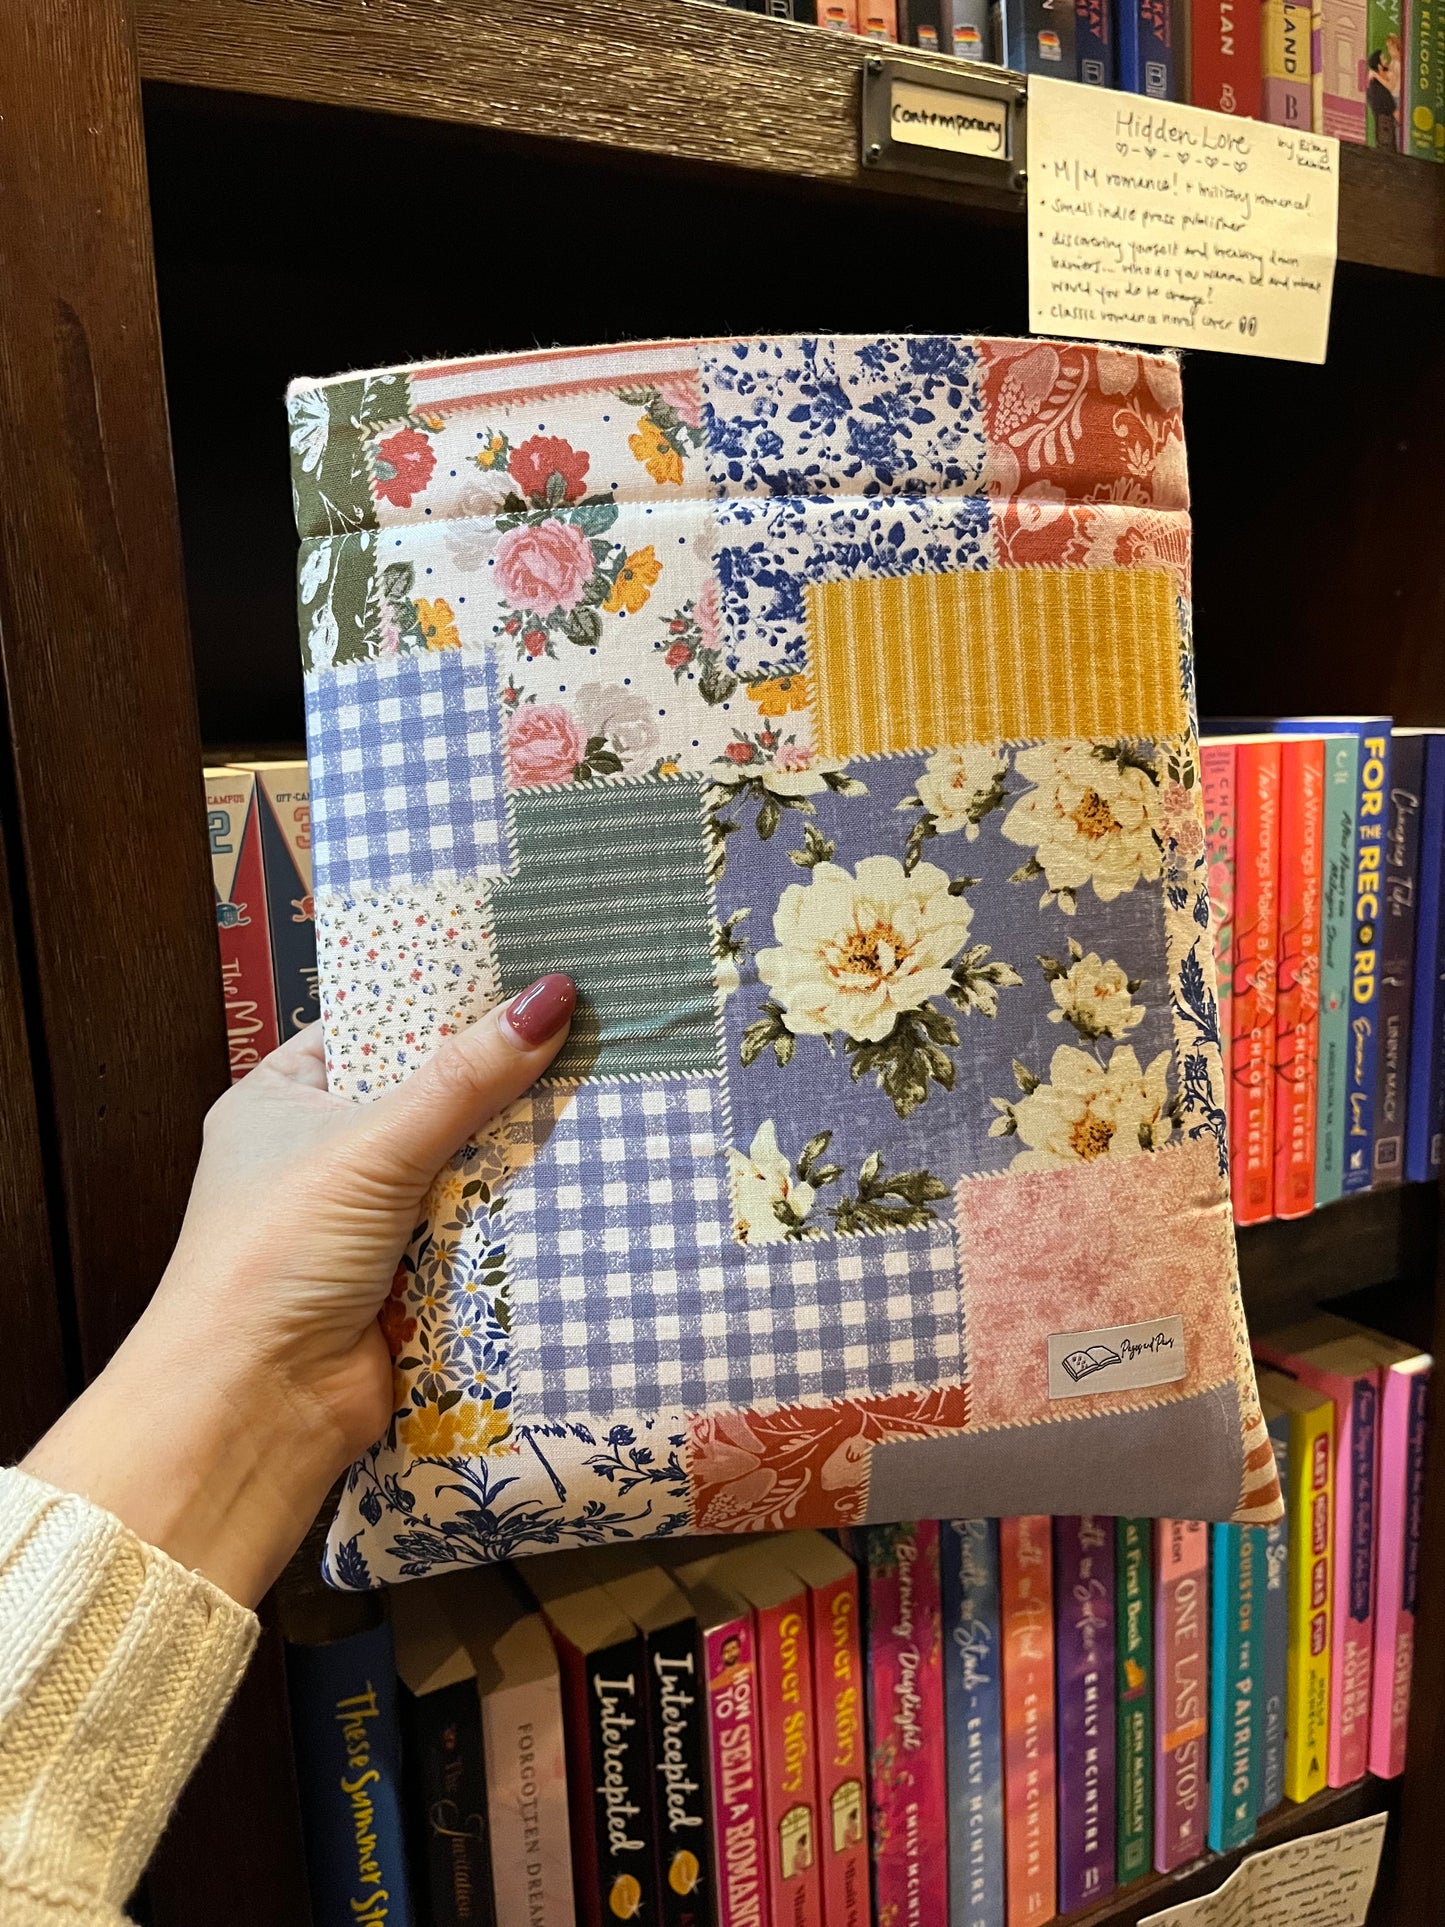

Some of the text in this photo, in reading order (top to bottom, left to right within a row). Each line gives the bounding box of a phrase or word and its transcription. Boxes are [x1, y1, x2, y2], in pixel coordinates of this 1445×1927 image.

[891, 103, 1002, 152] Contemporary
[1116, 110, 1251, 155] Hidden Love
[207, 794, 245, 806] CAMPUS
[276, 793, 310, 803] OFF-CA
[1300, 796, 1319, 874] Wrongs
[1255, 799, 1275, 878] Wrongs
[1257, 881, 1272, 932] Make
[1302, 878, 1316, 930] Make
[1302, 933, 1314, 947] a
[1350, 737, 1386, 1136] FOR THE RECORD Emma Lord
[1257, 937, 1270, 951] a
[1247, 1027, 1262, 1170] CHLOE LIESE
[1291, 1023, 1306, 1164] CHLOE LIESE
[1313, 1437, 1326, 1487] LAST
[1127, 1549, 1141, 1597] First
[1175, 1579, 1197, 1645] ONE
[831, 1590, 853, 1680] Cover
[892, 1537, 922, 1750] Burning Daylight
[1127, 1600, 1141, 1651] Book
[336, 1680, 380, 1768] These
[714, 1688, 734, 1719] TO
[733, 1670, 751, 1720] HOW
[779, 1614, 807, 1792] Cover Story
[1025, 1694, 1039, 1759] EMILY
[1084, 1672, 1098, 1737] EMILY
[1175, 1654, 1198, 1733] LAST
[1342, 1641, 1355, 1736] MONROE
[595, 1673, 645, 1856] Intercepted
[654, 1652, 702, 1832] Intercepted
[720, 1724, 754, 1805] SELL
[967, 1718, 983, 1784] EMILY
[1232, 1677, 1253, 1796] PAIRING
[517, 1723, 541, 1855] FORGOTTEN
[1085, 1748, 1098, 1853] MCINTIRE
[1175, 1742, 1198, 1811] STOP
[341, 1769, 383, 1885] Summer
[906, 1802, 919, 1857] EMILY
[969, 1795, 984, 1904] MCINTIRE
[1026, 1770, 1040, 1877] MCINTIRE
